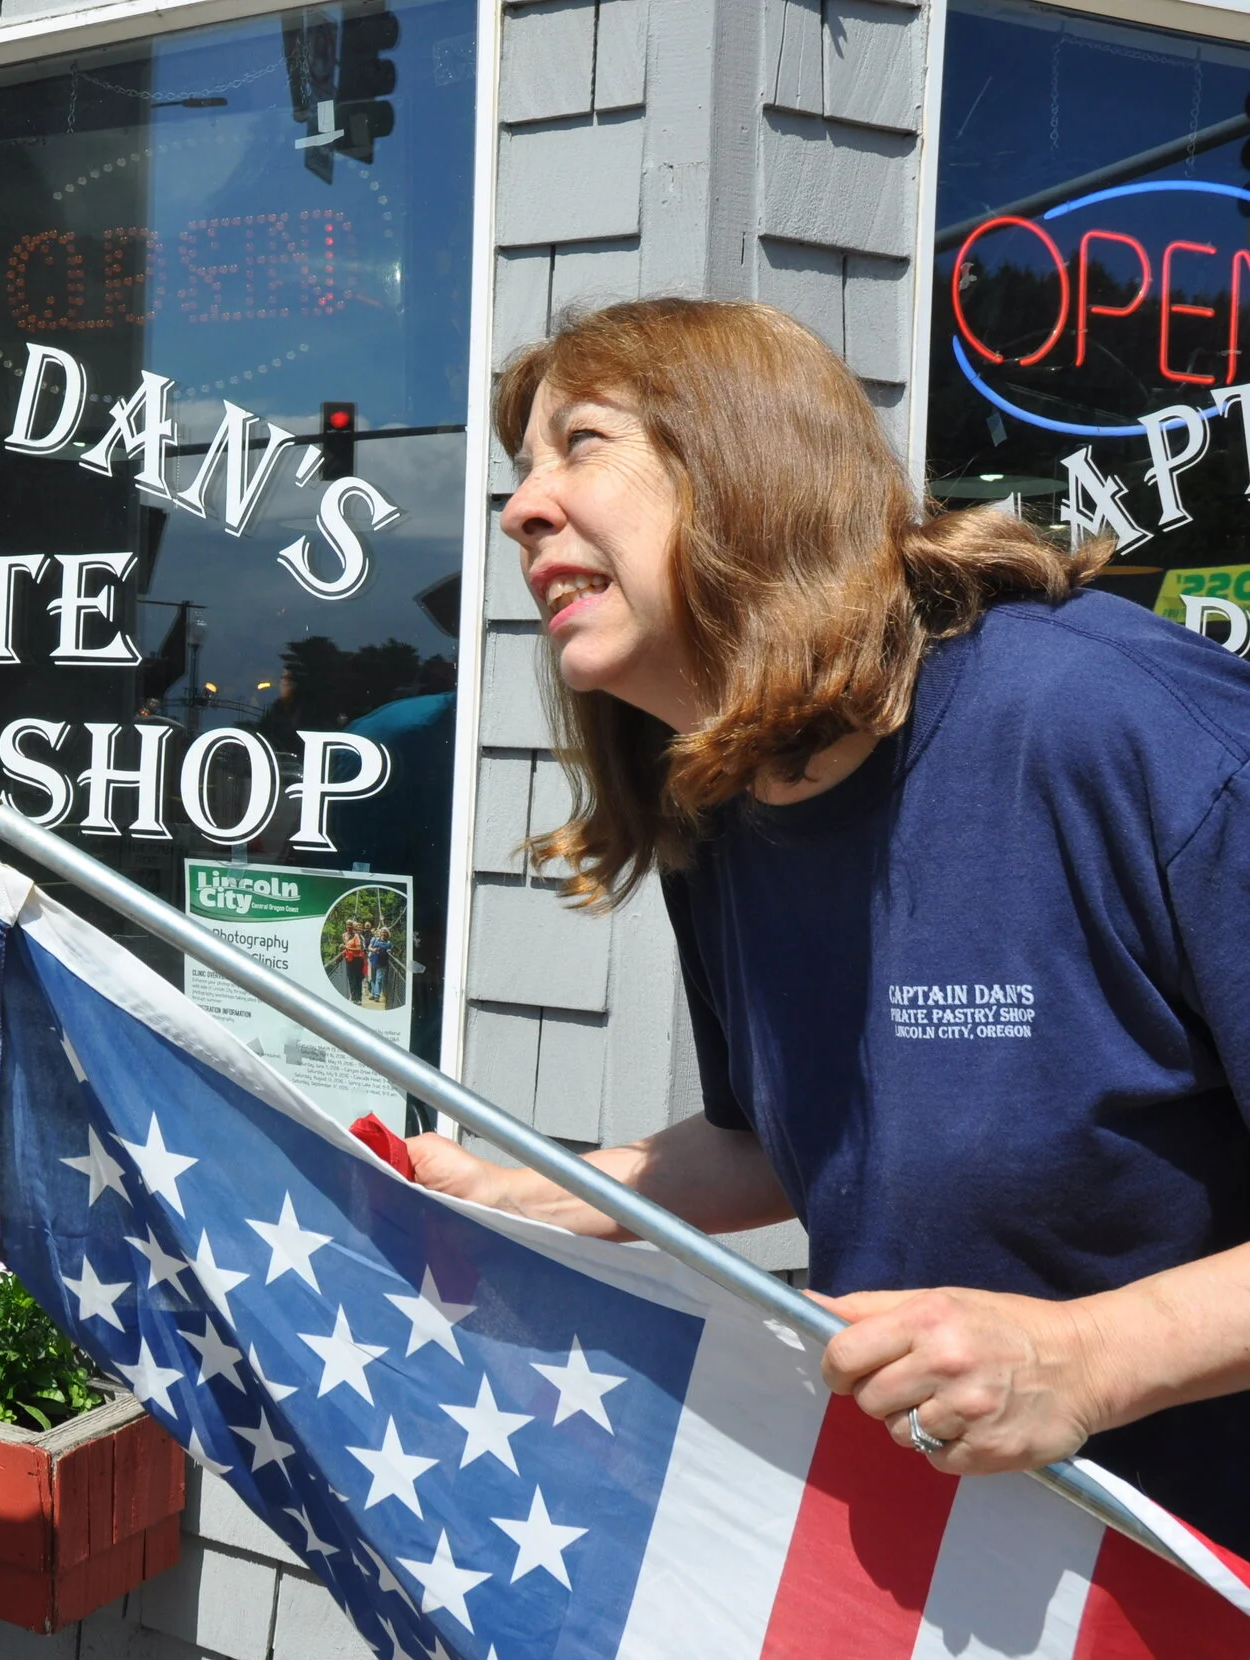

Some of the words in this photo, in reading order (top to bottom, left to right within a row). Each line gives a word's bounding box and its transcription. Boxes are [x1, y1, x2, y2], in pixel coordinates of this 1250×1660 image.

[4, 341, 401, 601] DAN'S
[197, 870, 299, 898] Lincoln
[199, 886, 253, 914] City
[251, 902, 269, 910] Central
[269, 903, 286, 912] Oregon
[286, 905, 299, 913] Coast
[889, 984, 967, 1006] CAPTAIN
[974, 984, 1035, 1006] DAN'S
[199, 1004, 222, 1014] STRATION
[222, 1008, 252, 1018] INFORMATION
[932, 1005, 998, 1024] PASTRY
[999, 1007, 1036, 1023] SHOP
[895, 1024, 935, 1039] LINCOLN
[938, 1023, 974, 1040] CITY,
[976, 1025, 1032, 1038] OREGON
